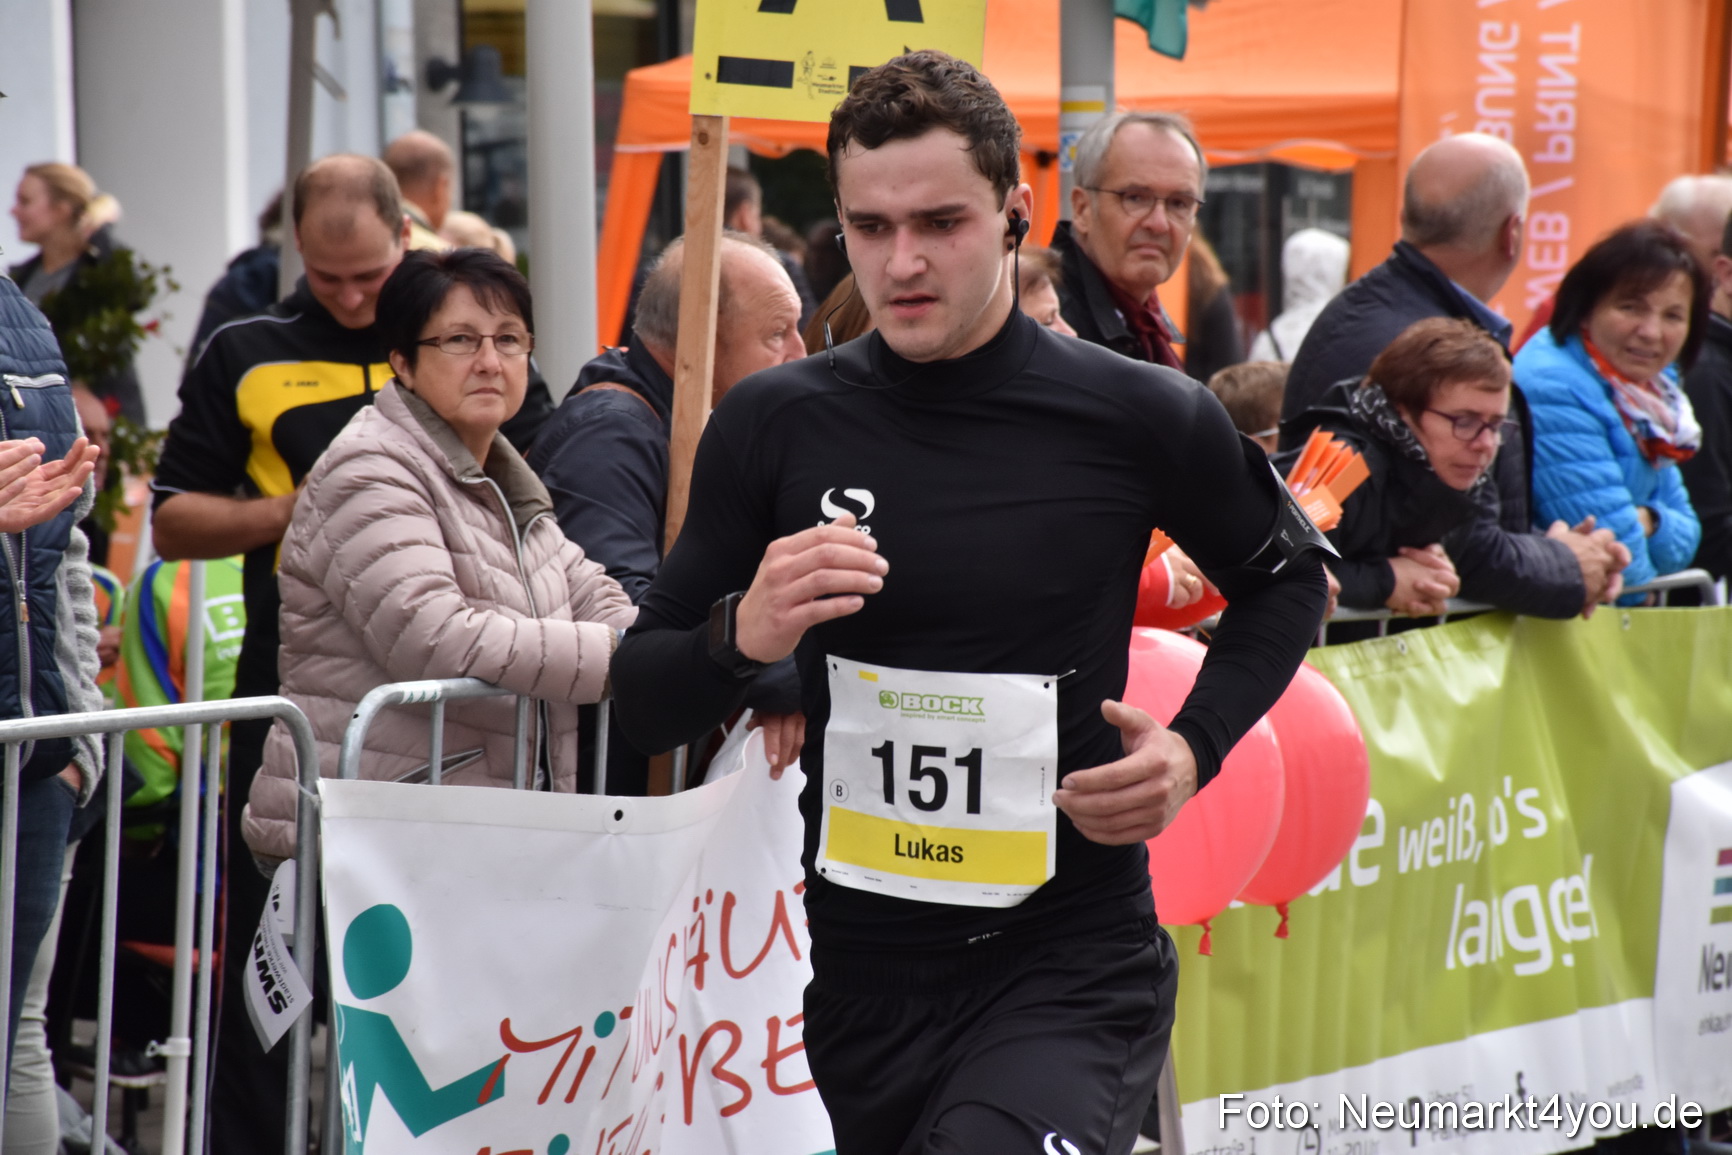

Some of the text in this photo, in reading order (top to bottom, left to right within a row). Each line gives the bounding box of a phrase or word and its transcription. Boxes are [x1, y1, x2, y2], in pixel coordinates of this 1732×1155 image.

[900, 692, 985, 716] BOCK
[871, 739, 982, 815] 151
[836, 785, 843, 798] B
[894, 833, 964, 864] Lukas
